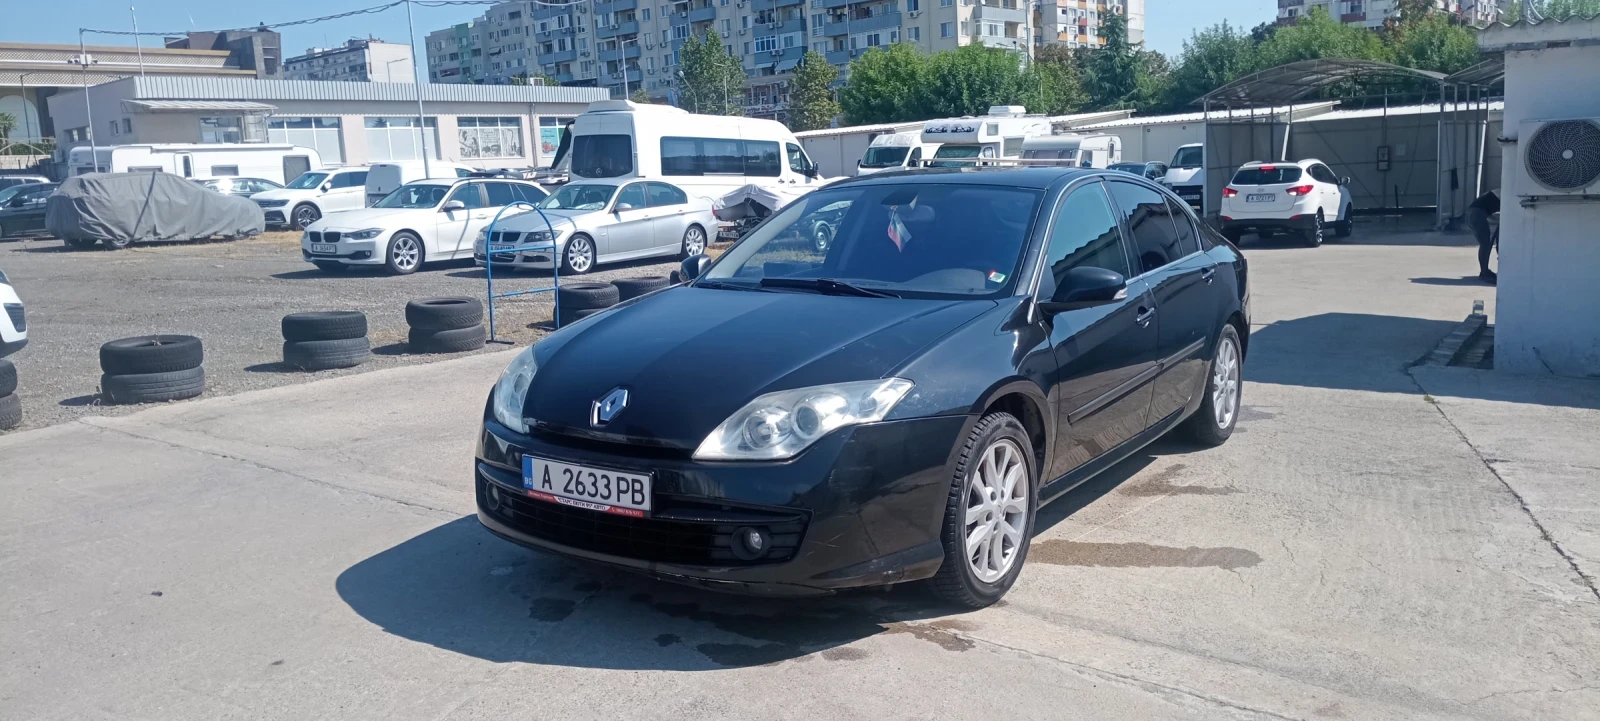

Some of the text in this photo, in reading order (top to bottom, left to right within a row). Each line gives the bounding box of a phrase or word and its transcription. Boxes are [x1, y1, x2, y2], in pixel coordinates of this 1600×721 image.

[525, 476, 532, 485] BG
[541, 464, 645, 506] A 2633 PB
